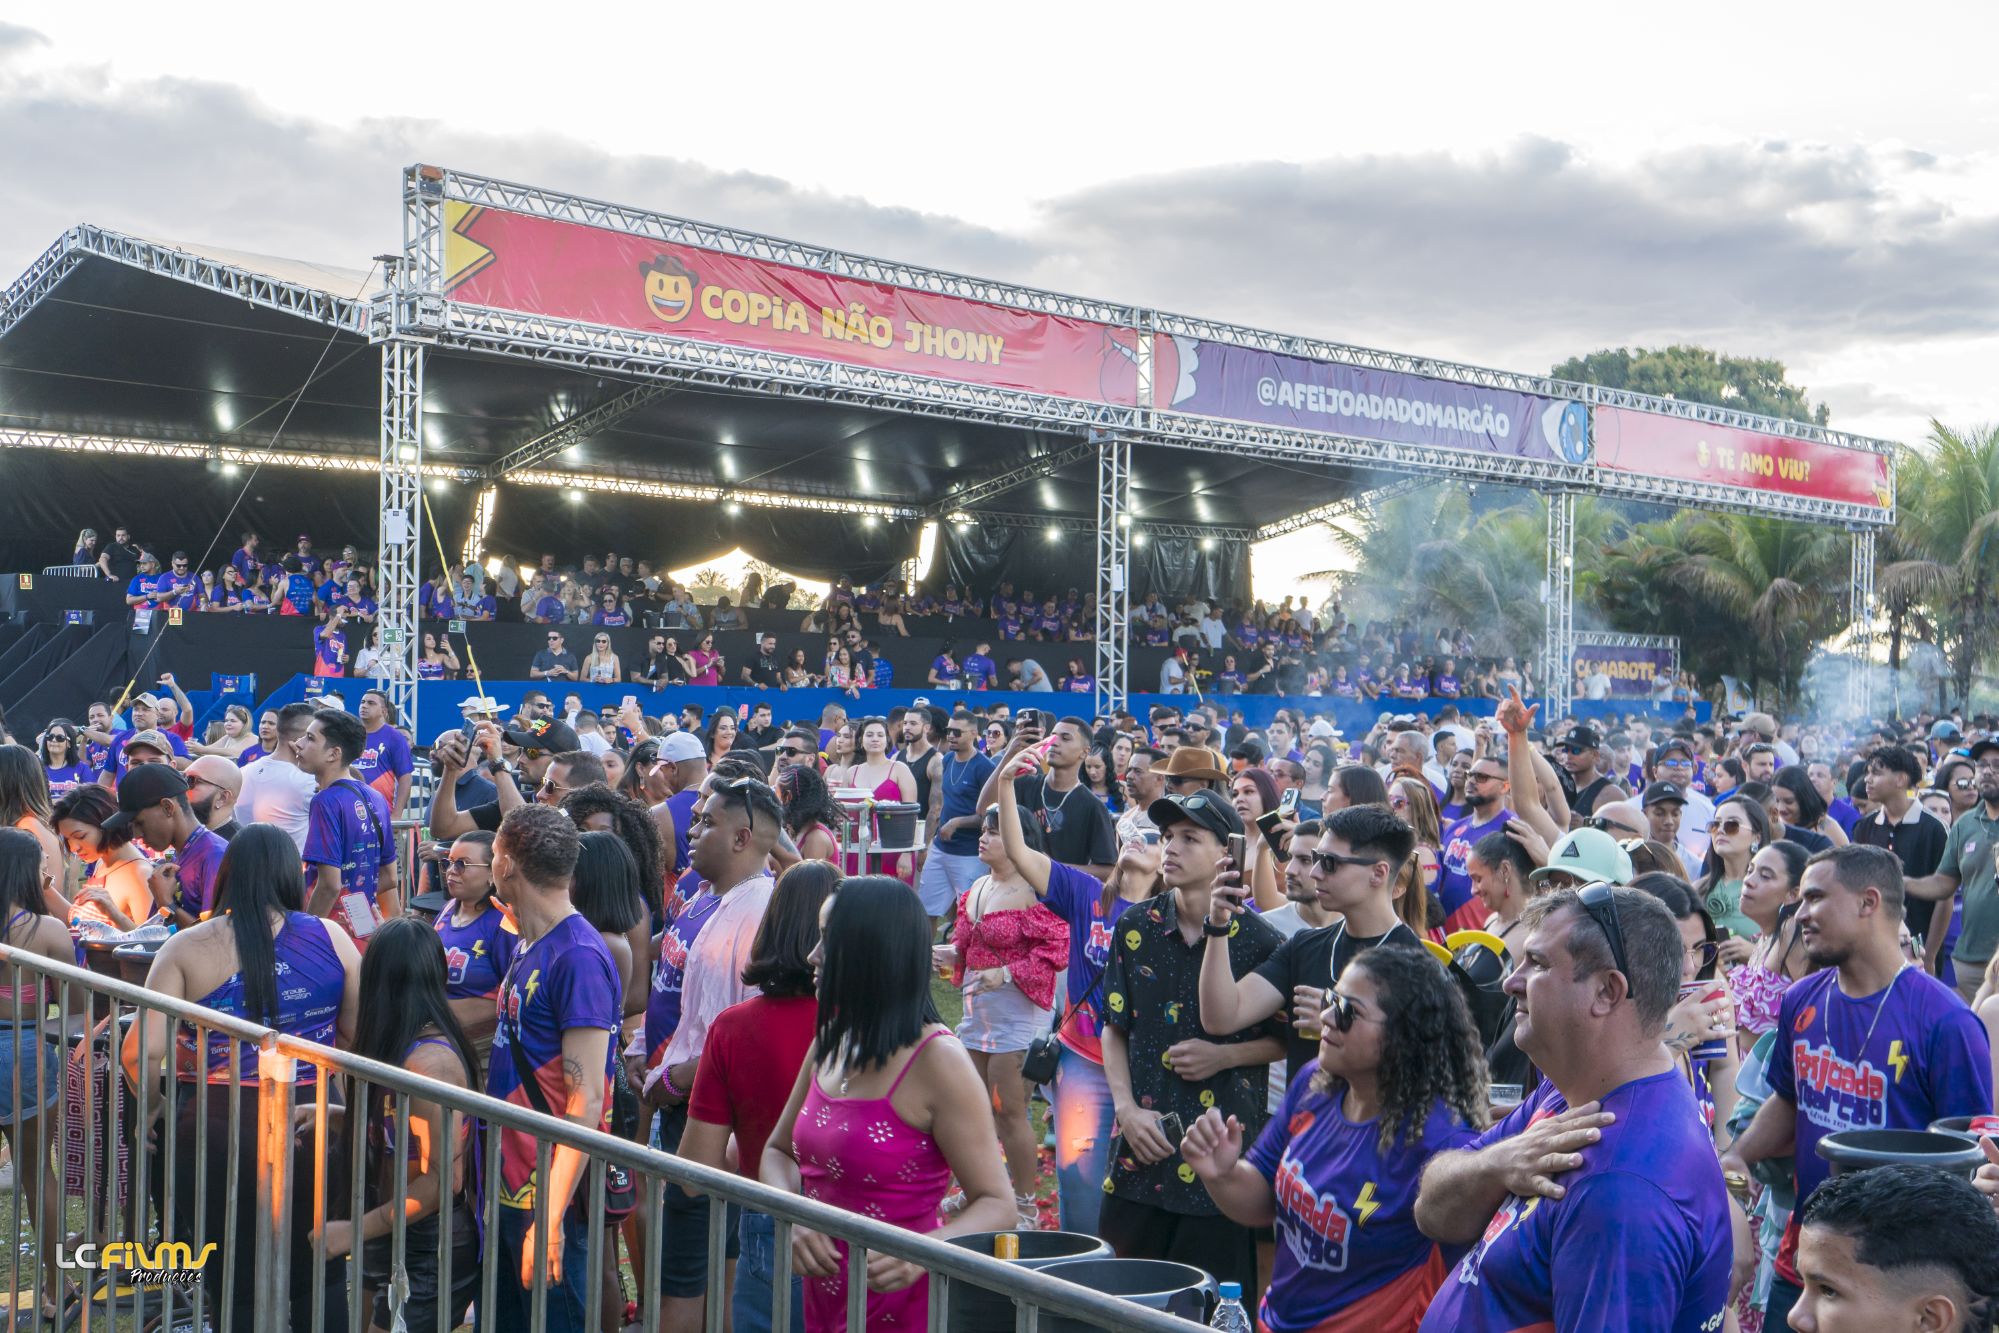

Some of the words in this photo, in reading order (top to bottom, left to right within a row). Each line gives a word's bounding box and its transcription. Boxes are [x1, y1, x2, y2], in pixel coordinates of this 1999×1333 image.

[821, 303, 894, 349] NÃO
[904, 320, 1005, 365] JHONY
[1716, 448, 1735, 471] TE
[1741, 453, 1774, 477] AMO
